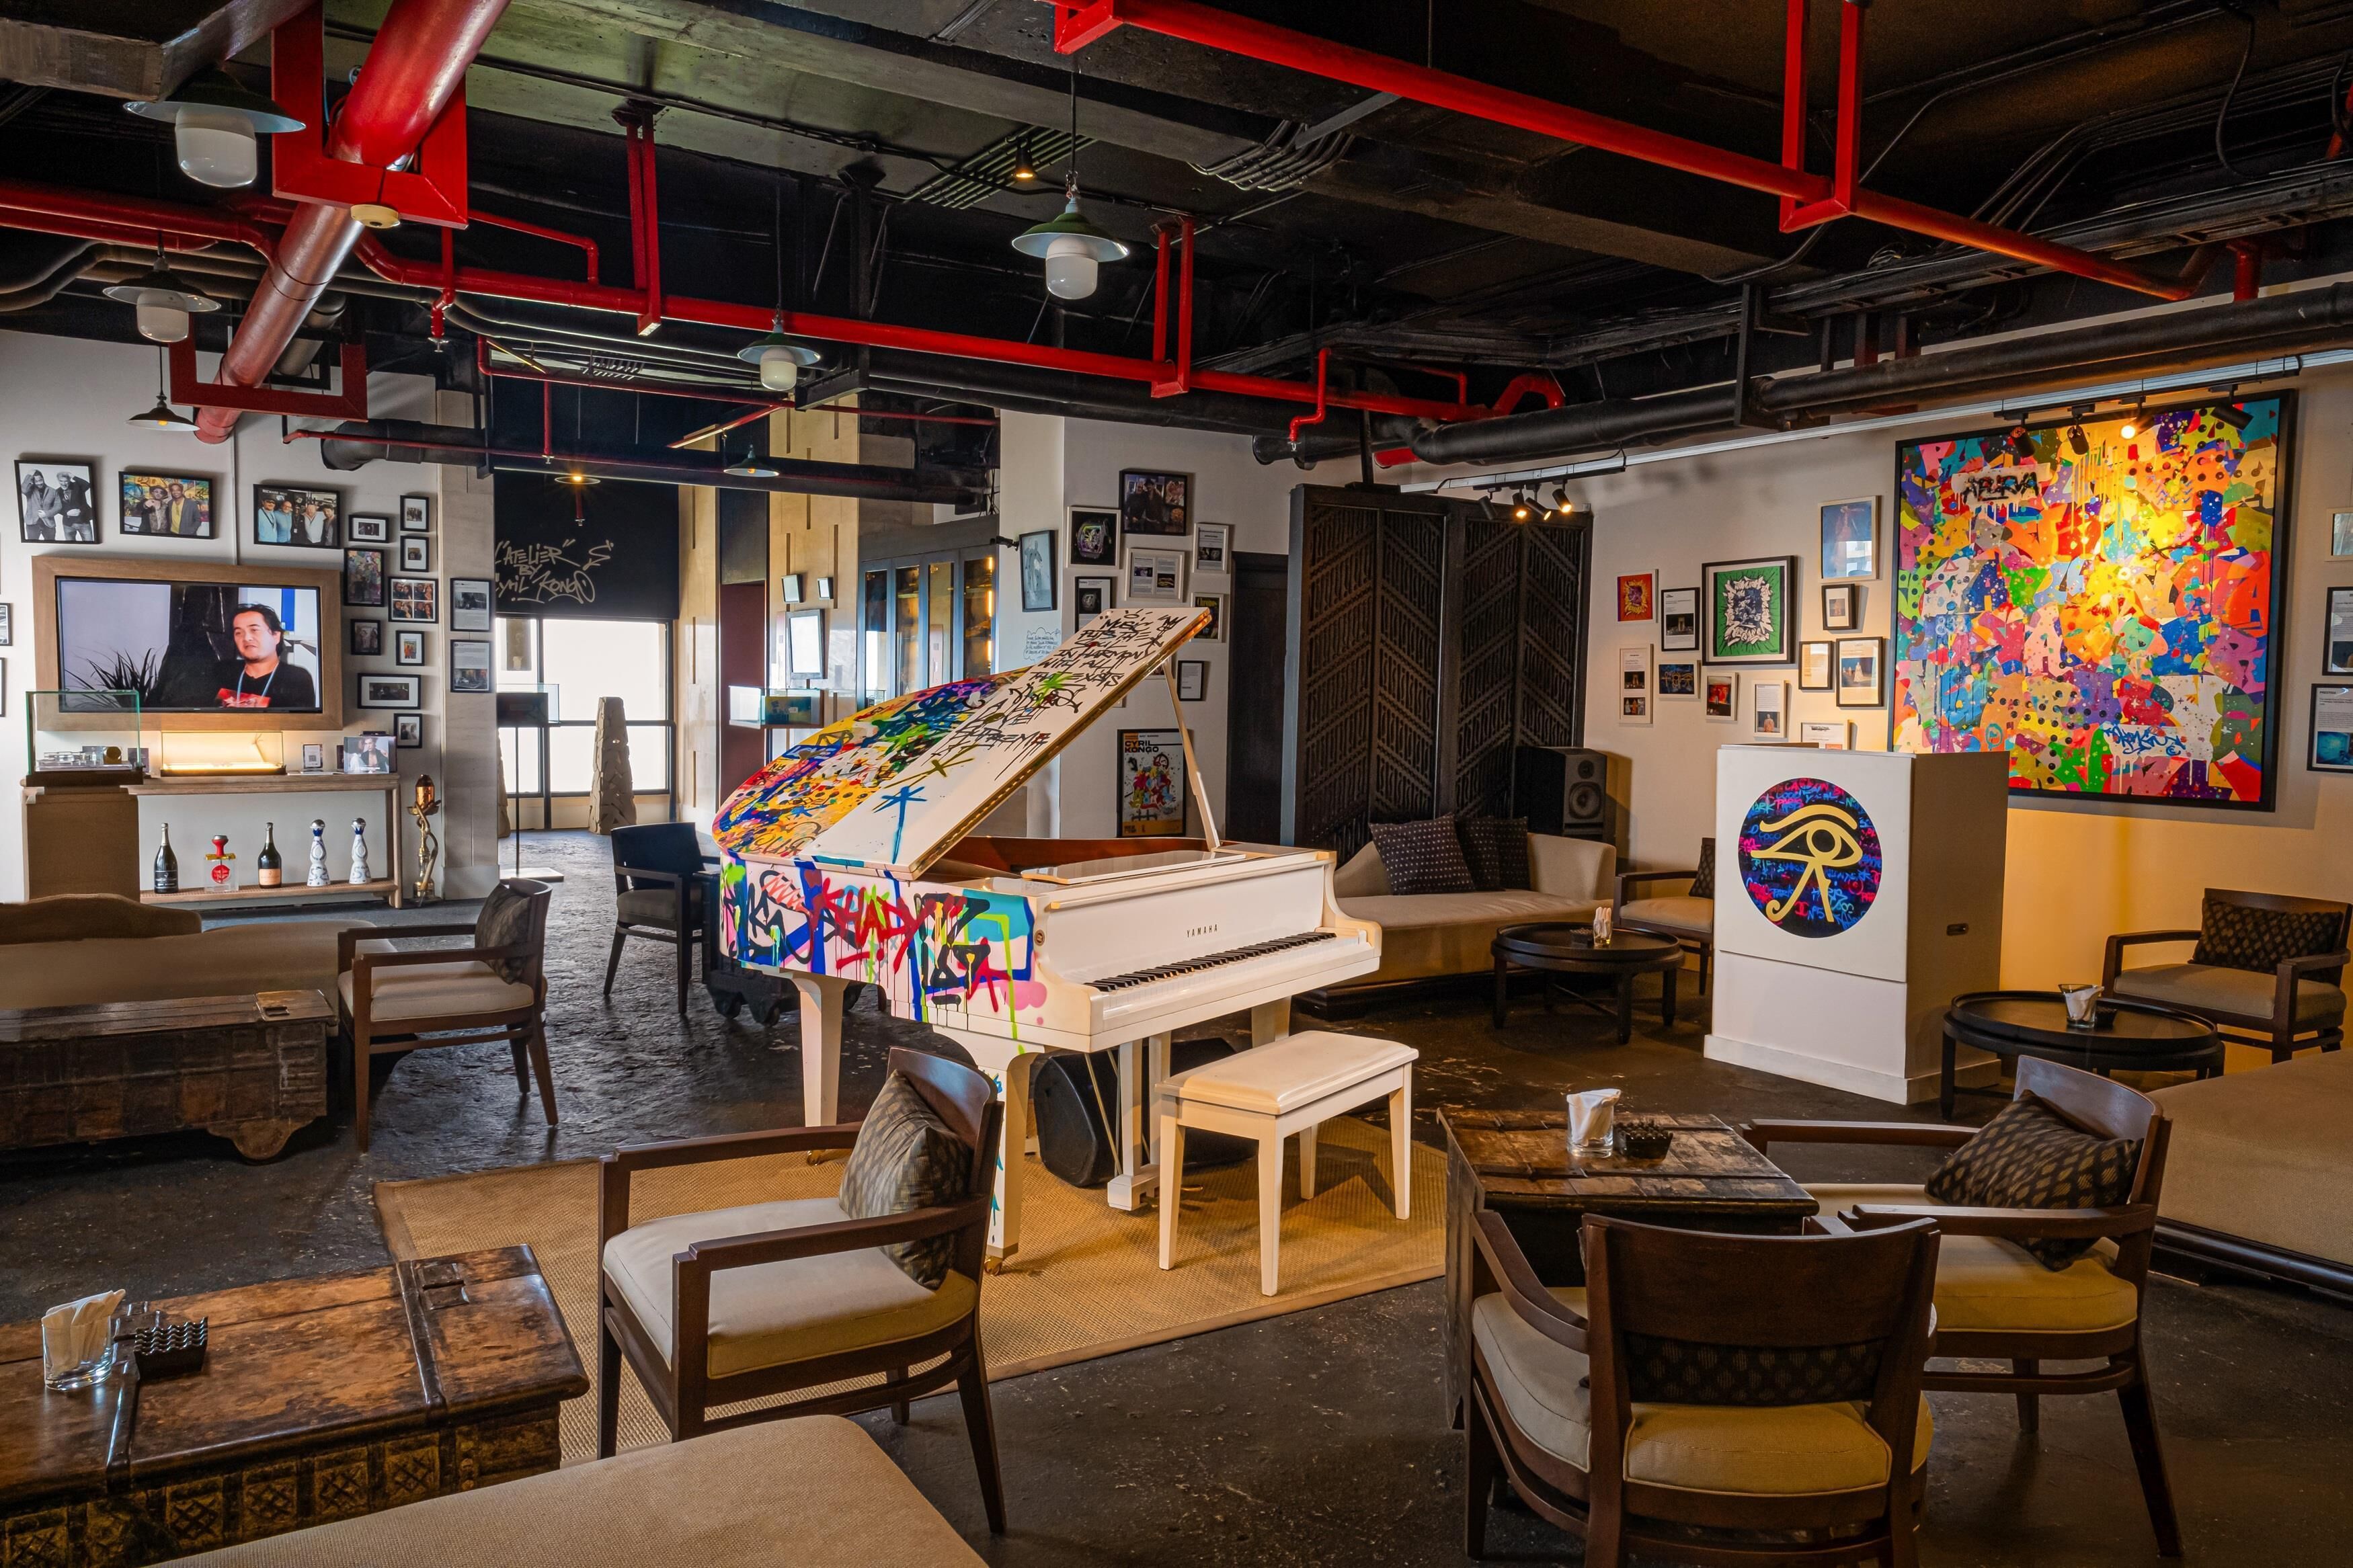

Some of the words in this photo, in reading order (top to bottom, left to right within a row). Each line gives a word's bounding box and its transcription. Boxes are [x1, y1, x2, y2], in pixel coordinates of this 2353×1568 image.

[514, 564, 543, 579] BY
[1100, 618, 1154, 633] MUSIC
[1187, 923, 1218, 938] YAMAHA
